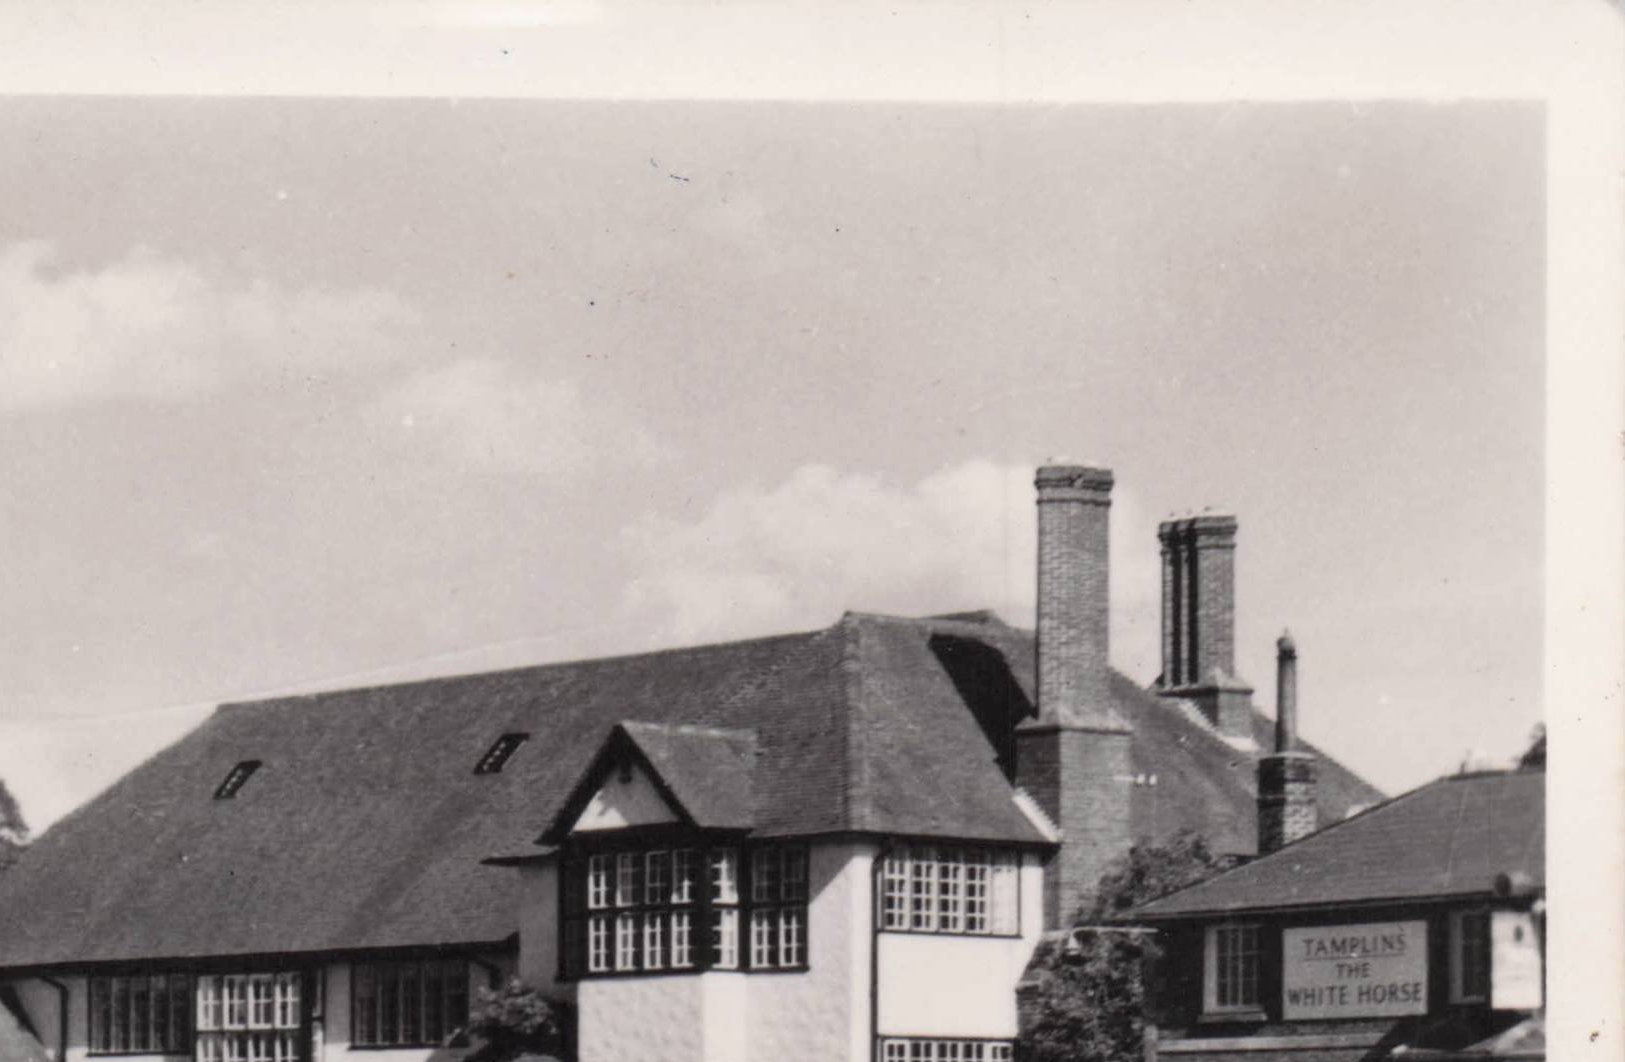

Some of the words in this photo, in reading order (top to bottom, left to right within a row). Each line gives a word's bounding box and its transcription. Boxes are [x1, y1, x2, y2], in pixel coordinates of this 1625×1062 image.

[1336, 962, 1370, 979] THE
[1288, 984, 1348, 1006] WHITE
[1358, 982, 1422, 1004] HORSE
